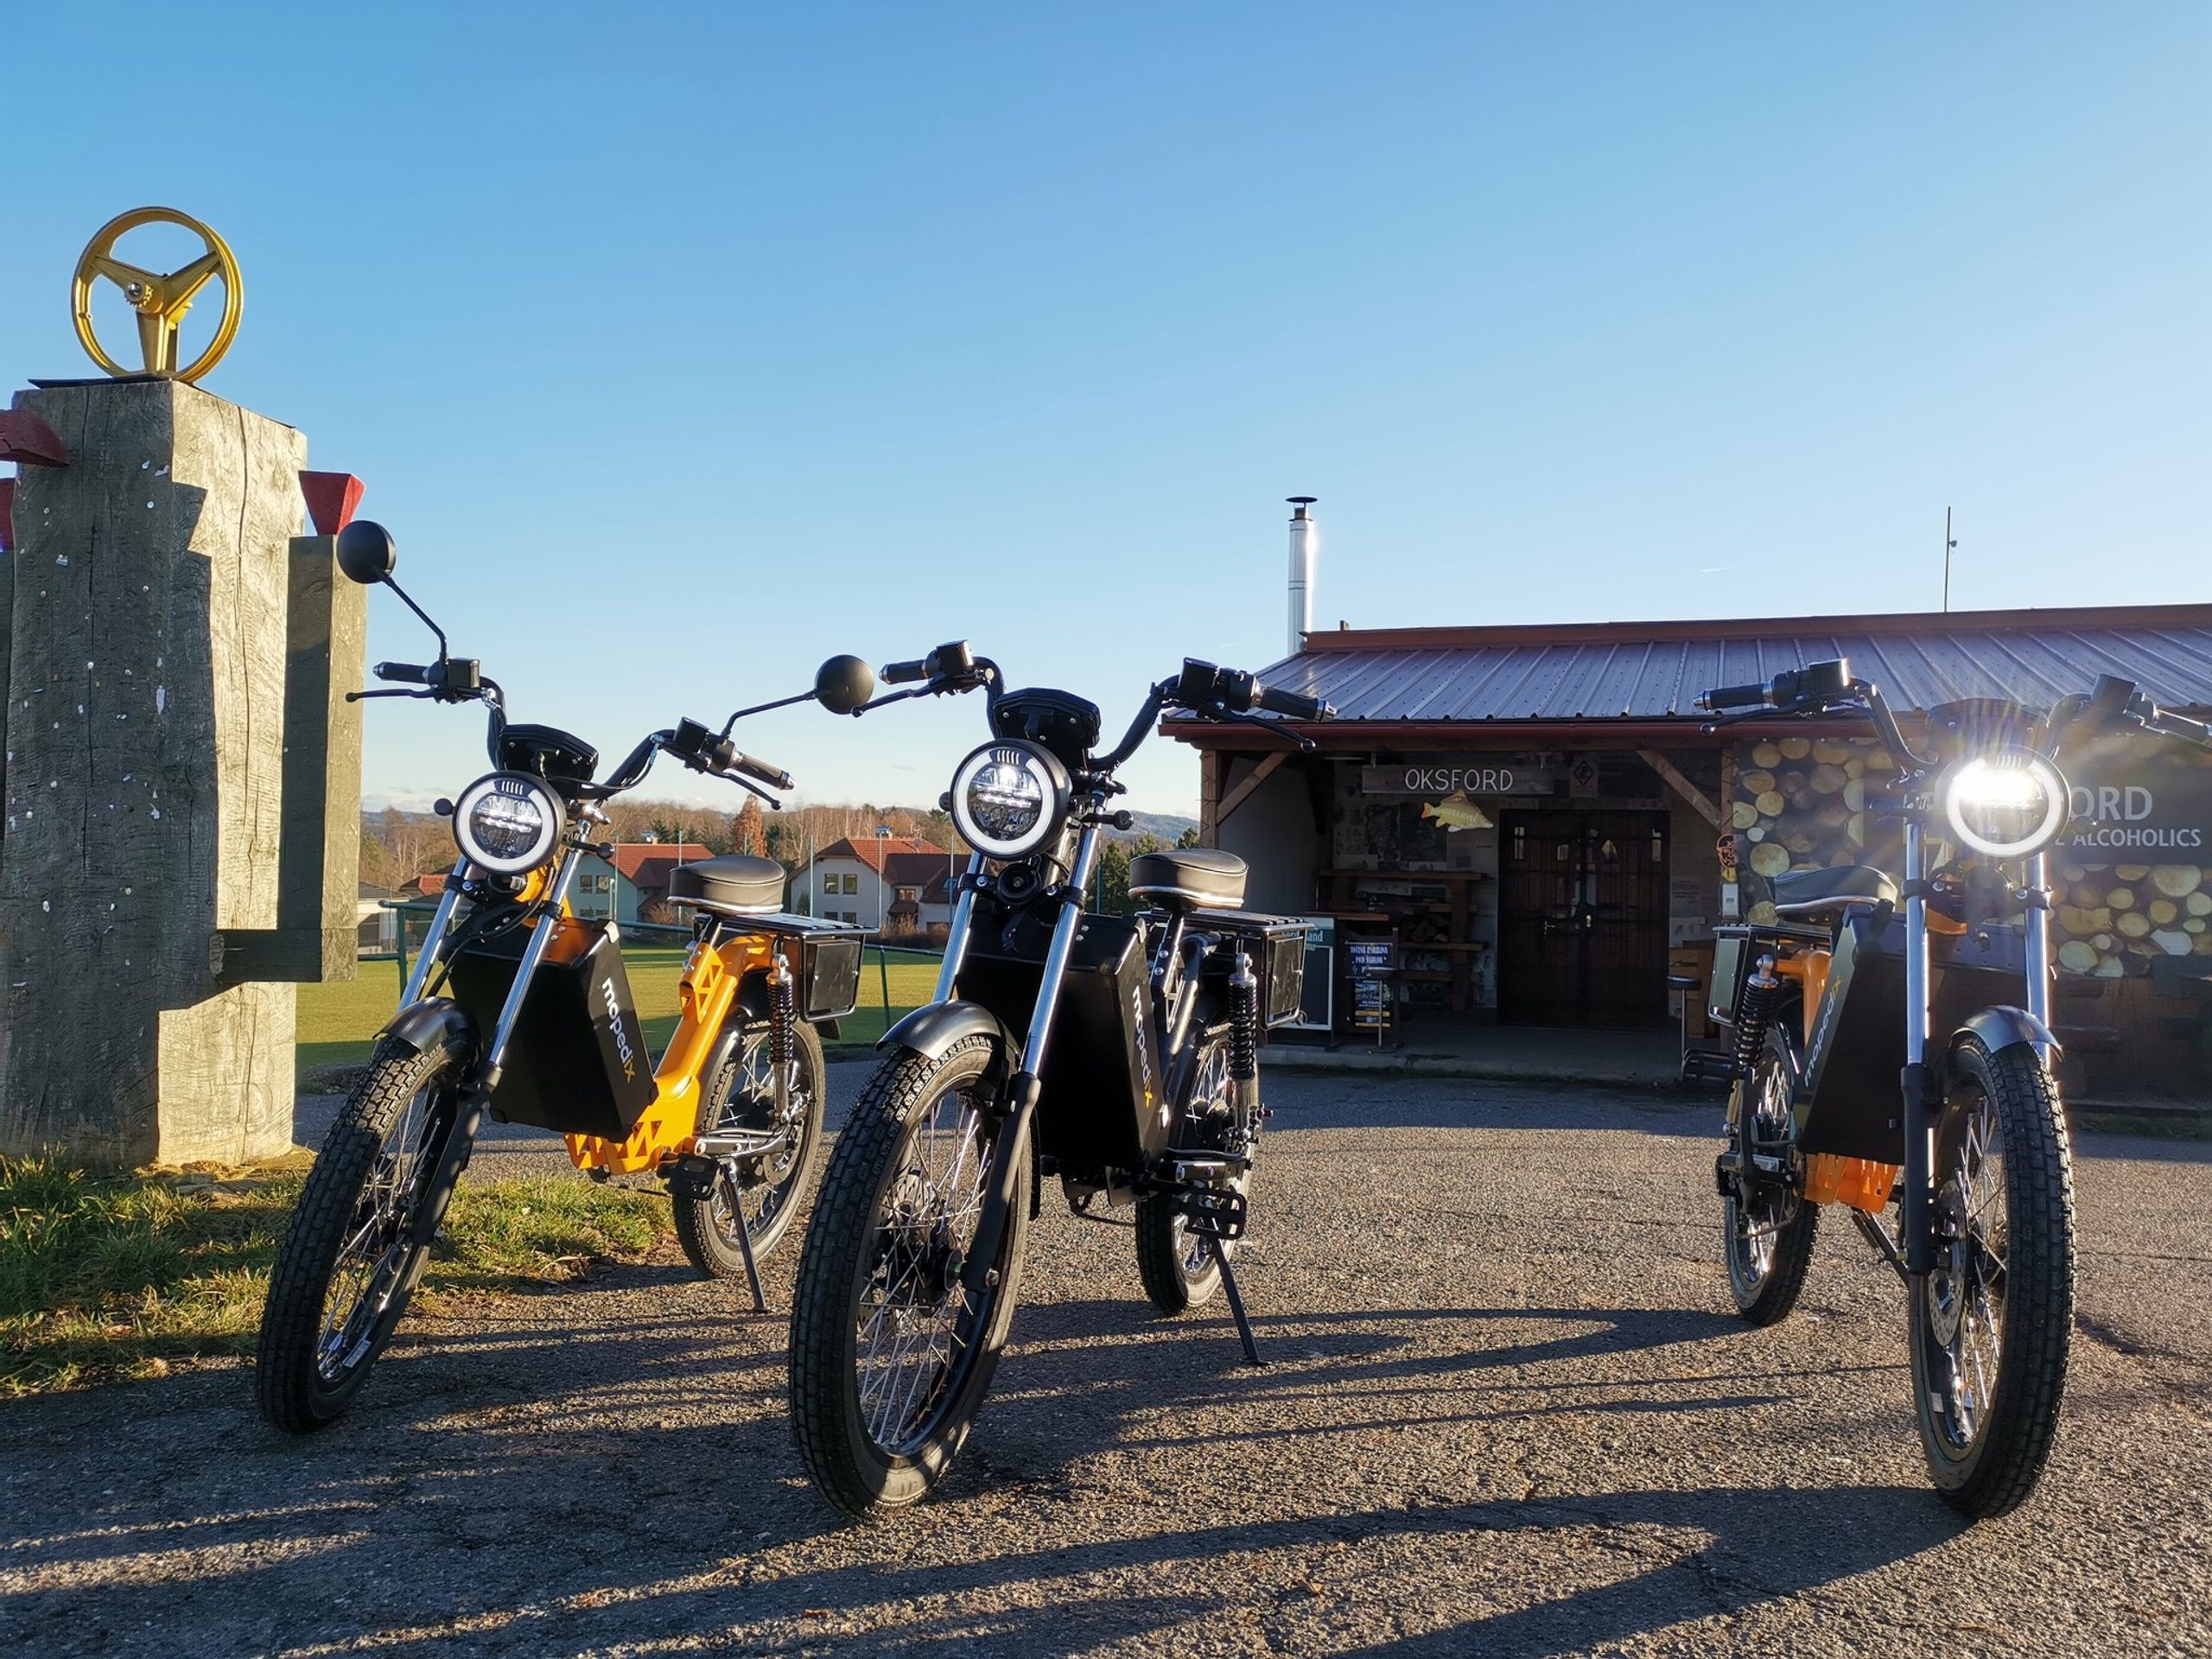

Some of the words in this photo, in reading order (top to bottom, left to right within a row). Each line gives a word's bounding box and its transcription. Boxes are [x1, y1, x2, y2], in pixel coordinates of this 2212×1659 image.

[1405, 768, 1514, 791] OKSFORD
[2069, 785, 2153, 822] ORD
[2072, 829, 2202, 848] ALCOHOLICS
[1307, 930, 1324, 942] and
[601, 977, 637, 1084] mopedix
[1132, 985, 1154, 1109] mopedix
[1804, 974, 1841, 1088] mopedix
